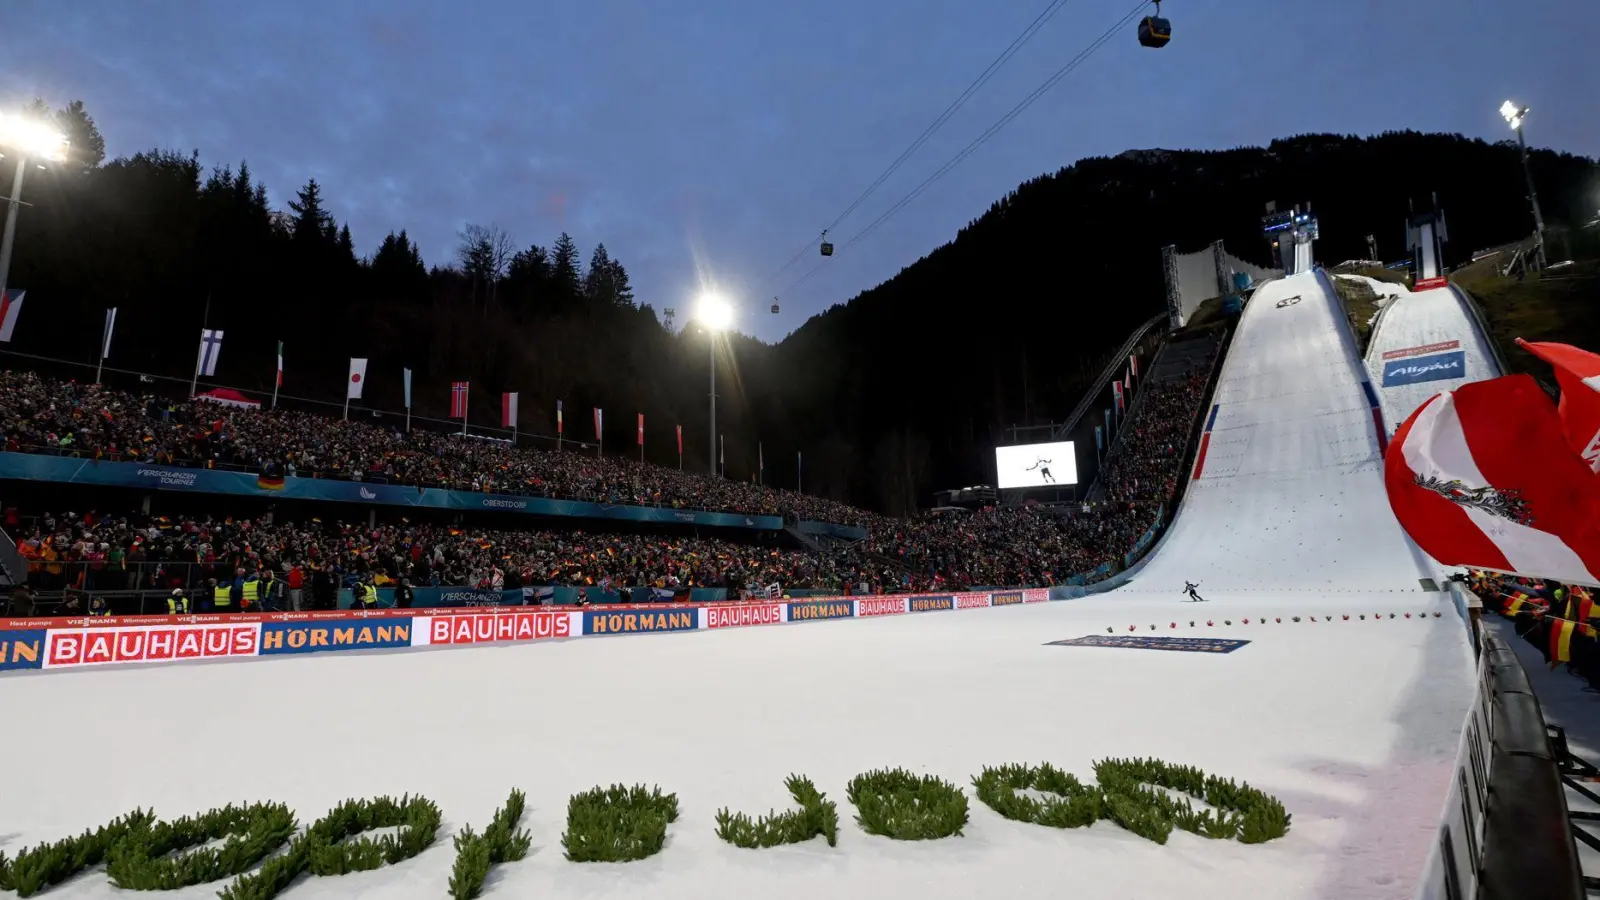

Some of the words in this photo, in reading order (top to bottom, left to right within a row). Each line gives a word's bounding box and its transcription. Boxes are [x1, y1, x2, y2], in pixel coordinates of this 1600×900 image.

[137, 469, 197, 480] VIERSCHANZEN
[160, 477, 196, 486] TOURNEE
[482, 499, 528, 508] OBERSTDORF
[440, 592, 503, 602] VIERSCHANZEN
[709, 605, 780, 626] BAUHAUS
[860, 600, 904, 614] BAUHAUS
[434, 616, 569, 641] BAUHAUS
[593, 612, 692, 633] HÖRMANN
[55, 629, 254, 660] BAUHAUS
[263, 625, 410, 650] HÖRMANN
